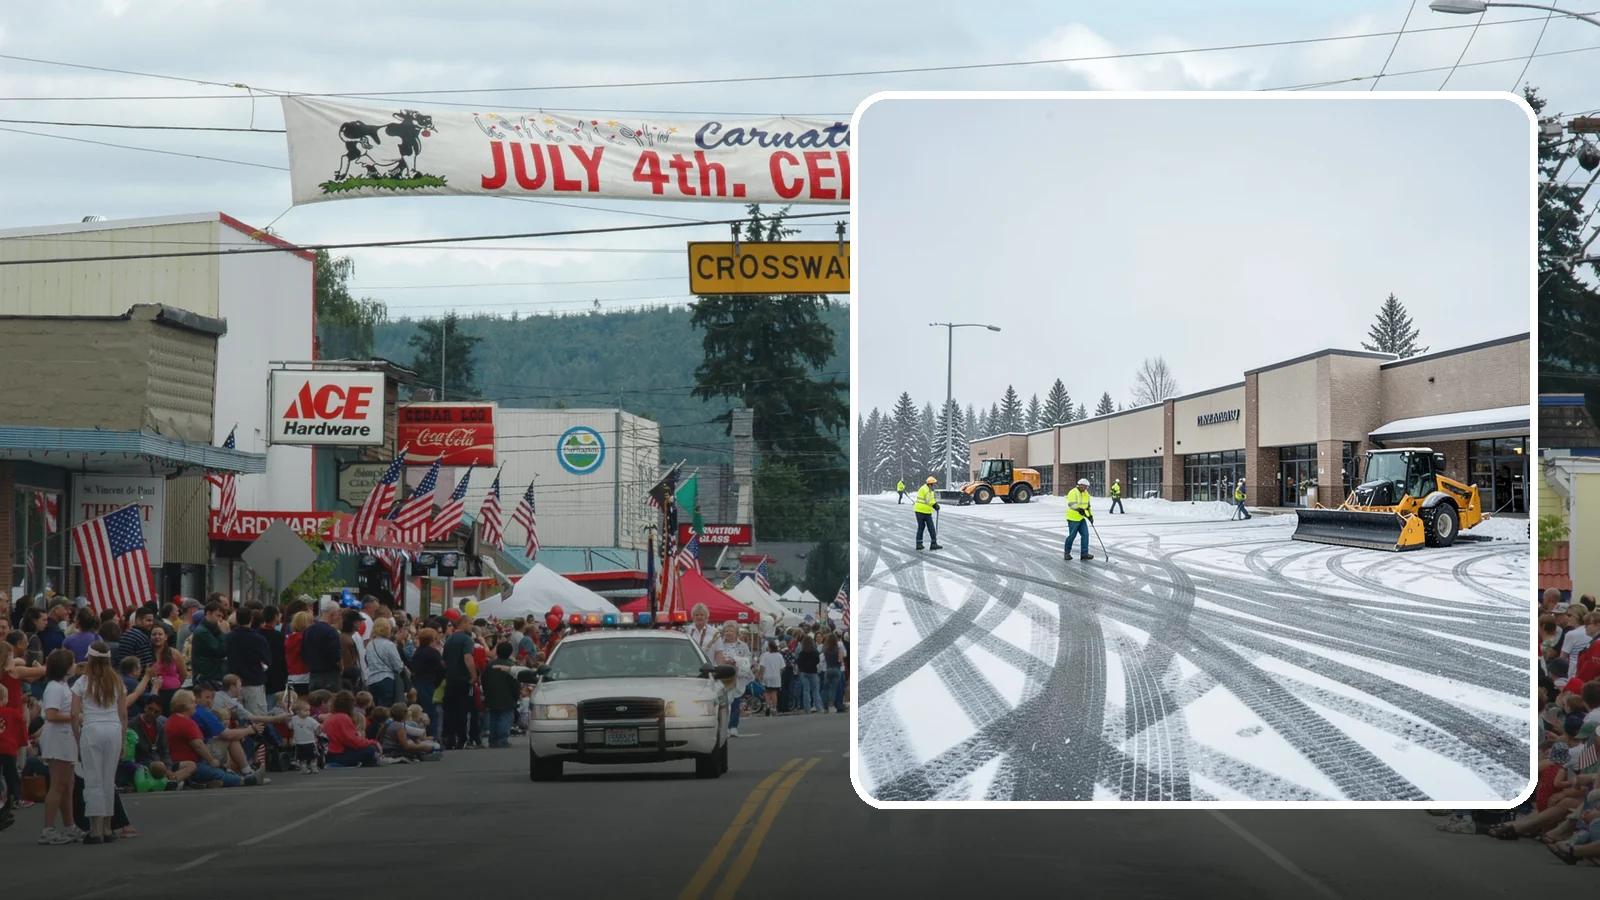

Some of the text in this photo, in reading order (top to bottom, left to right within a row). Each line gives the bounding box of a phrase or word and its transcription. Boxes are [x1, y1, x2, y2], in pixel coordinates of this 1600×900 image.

[481, 141, 605, 192] JULY
[632, 150, 746, 197] 4th.
[697, 254, 850, 280] CROSSWA
[282, 380, 373, 420] ACE
[405, 409, 452, 421] CEDAR
[283, 421, 371, 436] Hardware
[416, 428, 477, 446] Coca-Cola
[96, 485, 124, 494] Vincent
[126, 486, 136, 495] de
[137, 486, 155, 495] Paul
[688, 526, 741, 535] CRNATION
[699, 535, 730, 543] GLASS
